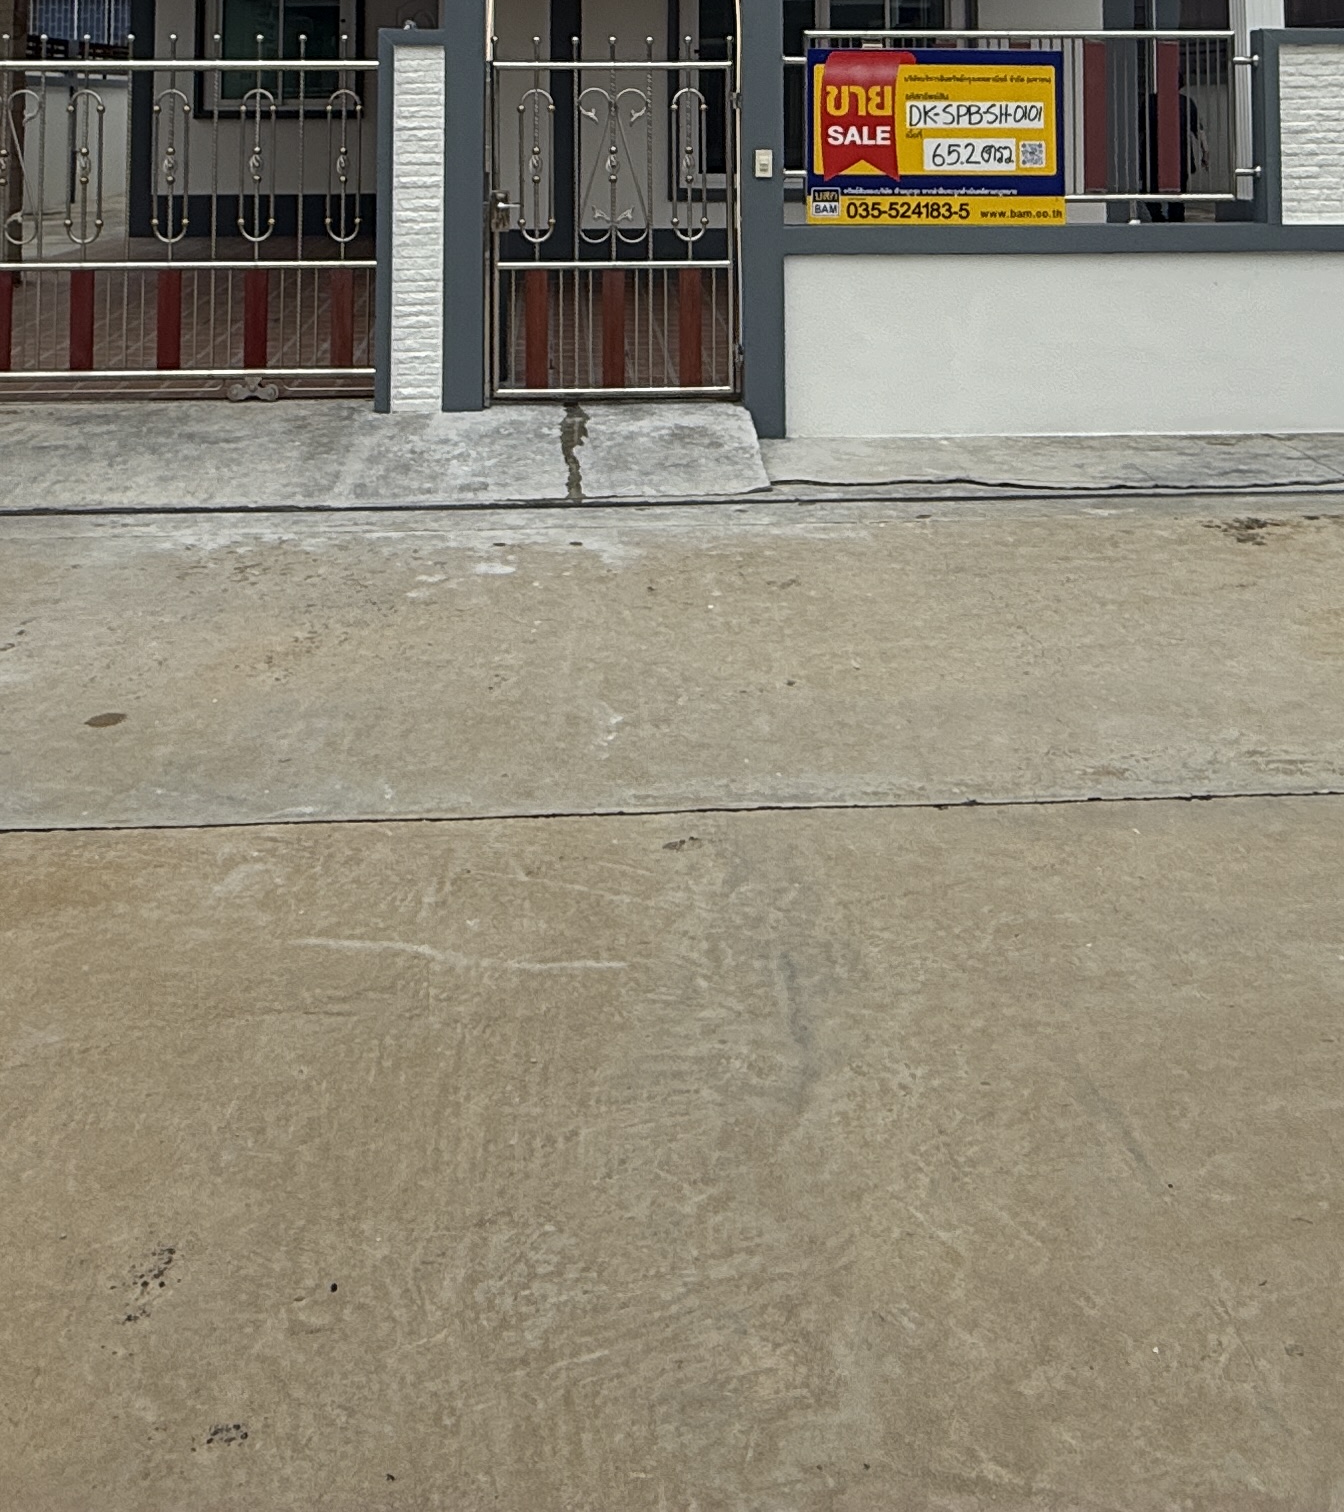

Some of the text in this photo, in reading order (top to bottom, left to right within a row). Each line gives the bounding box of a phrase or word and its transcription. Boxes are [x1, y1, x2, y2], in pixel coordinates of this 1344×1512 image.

[826, 85, 892, 116] ขาย
[827, 125, 891, 145] SALE
[814, 203, 837, 214] BAM
[846, 202, 1062, 219] 035-524183-5 www.bam.co.th
